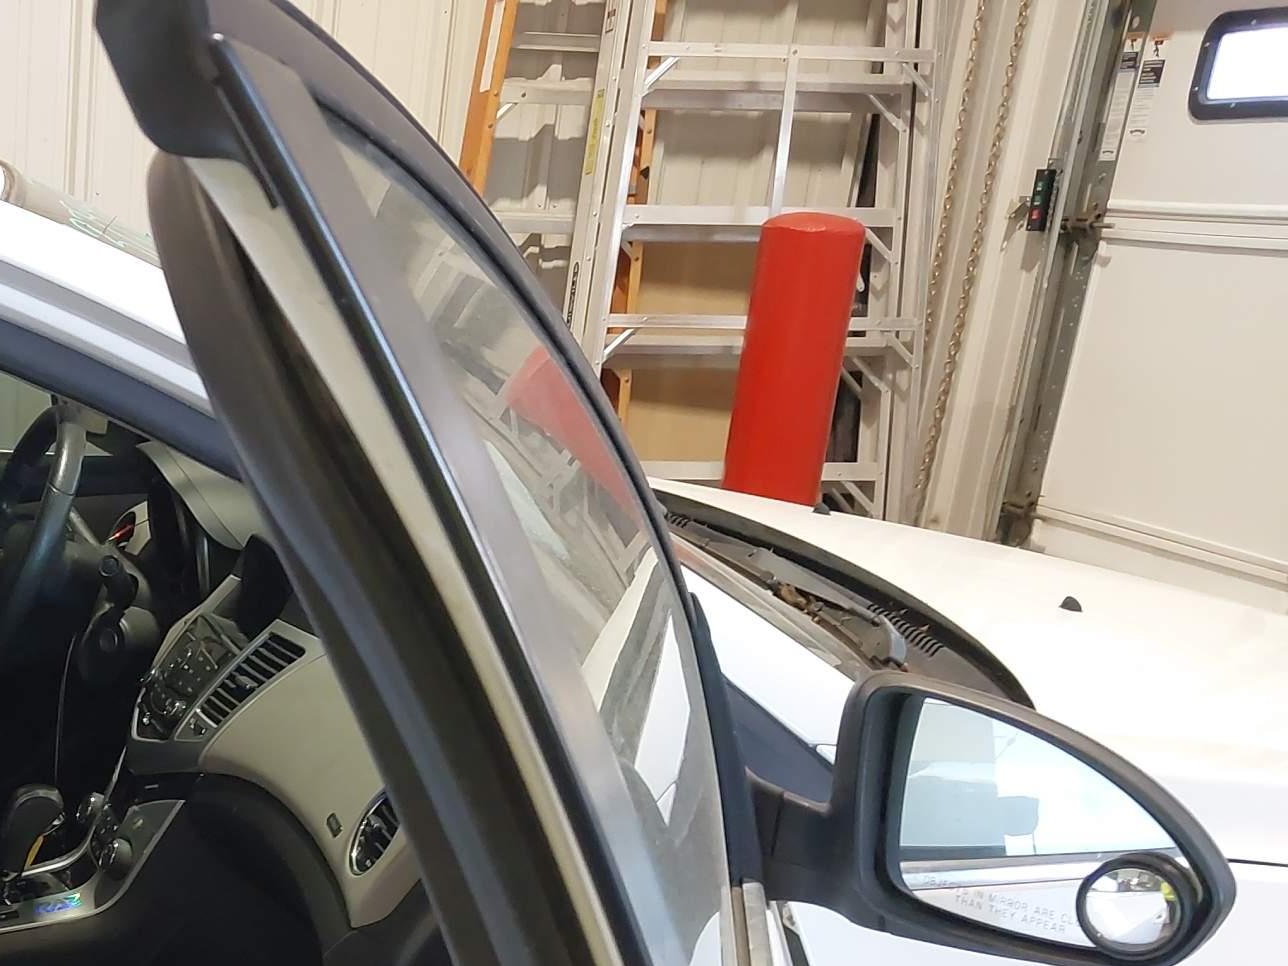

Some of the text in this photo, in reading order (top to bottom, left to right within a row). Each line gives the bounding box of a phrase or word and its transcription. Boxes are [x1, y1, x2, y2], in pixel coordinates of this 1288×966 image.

[955, 894, 1066, 933] THAN THEY APPEAR
